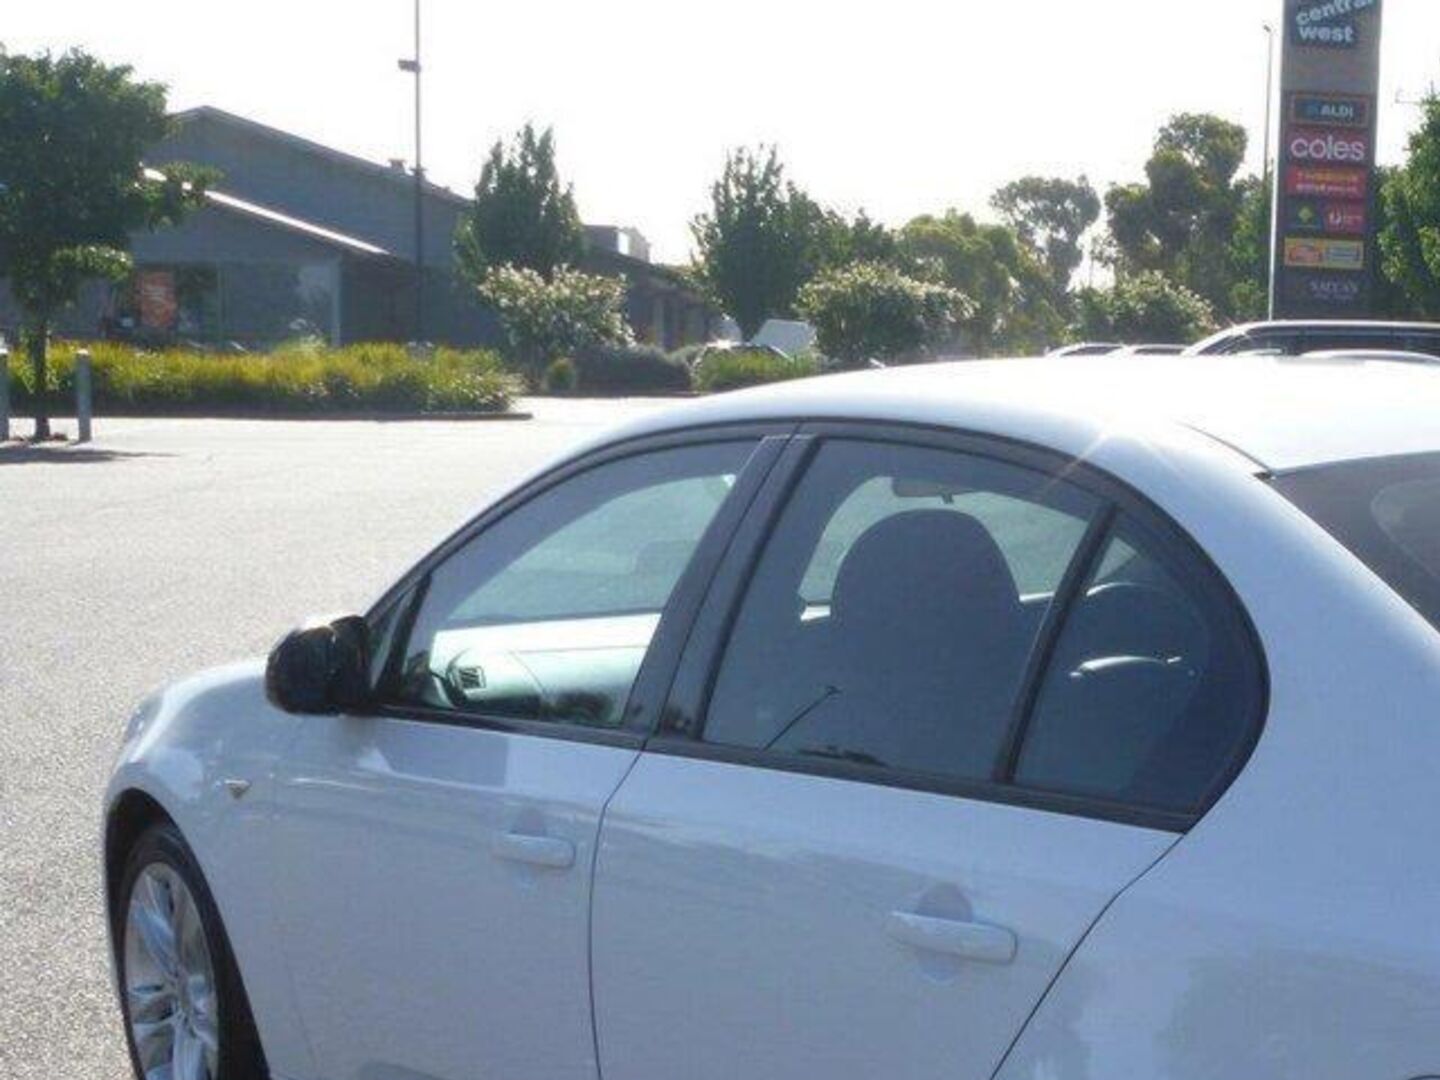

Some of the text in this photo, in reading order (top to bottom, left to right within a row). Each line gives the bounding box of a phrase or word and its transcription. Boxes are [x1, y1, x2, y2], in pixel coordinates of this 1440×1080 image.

[1300, 26, 1354, 42] west
[1320, 104, 1353, 118] ALDI
[1291, 135, 1364, 160] coles
